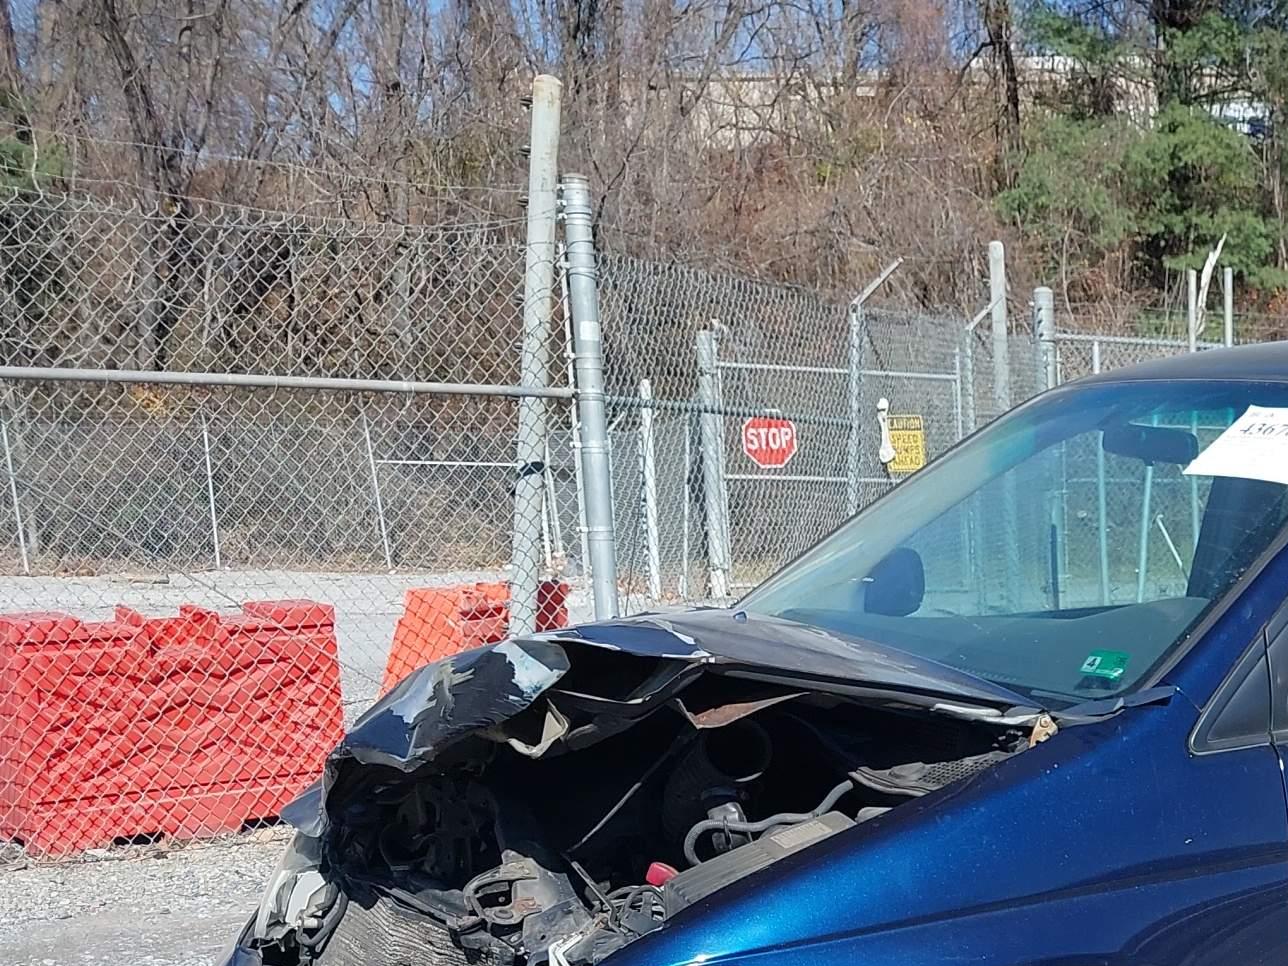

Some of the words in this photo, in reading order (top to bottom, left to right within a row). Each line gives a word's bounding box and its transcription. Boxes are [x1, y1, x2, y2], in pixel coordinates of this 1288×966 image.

[746, 427, 792, 450] STOP
[891, 433, 918, 444] SPEED
[893, 445, 920, 455] UMPS
